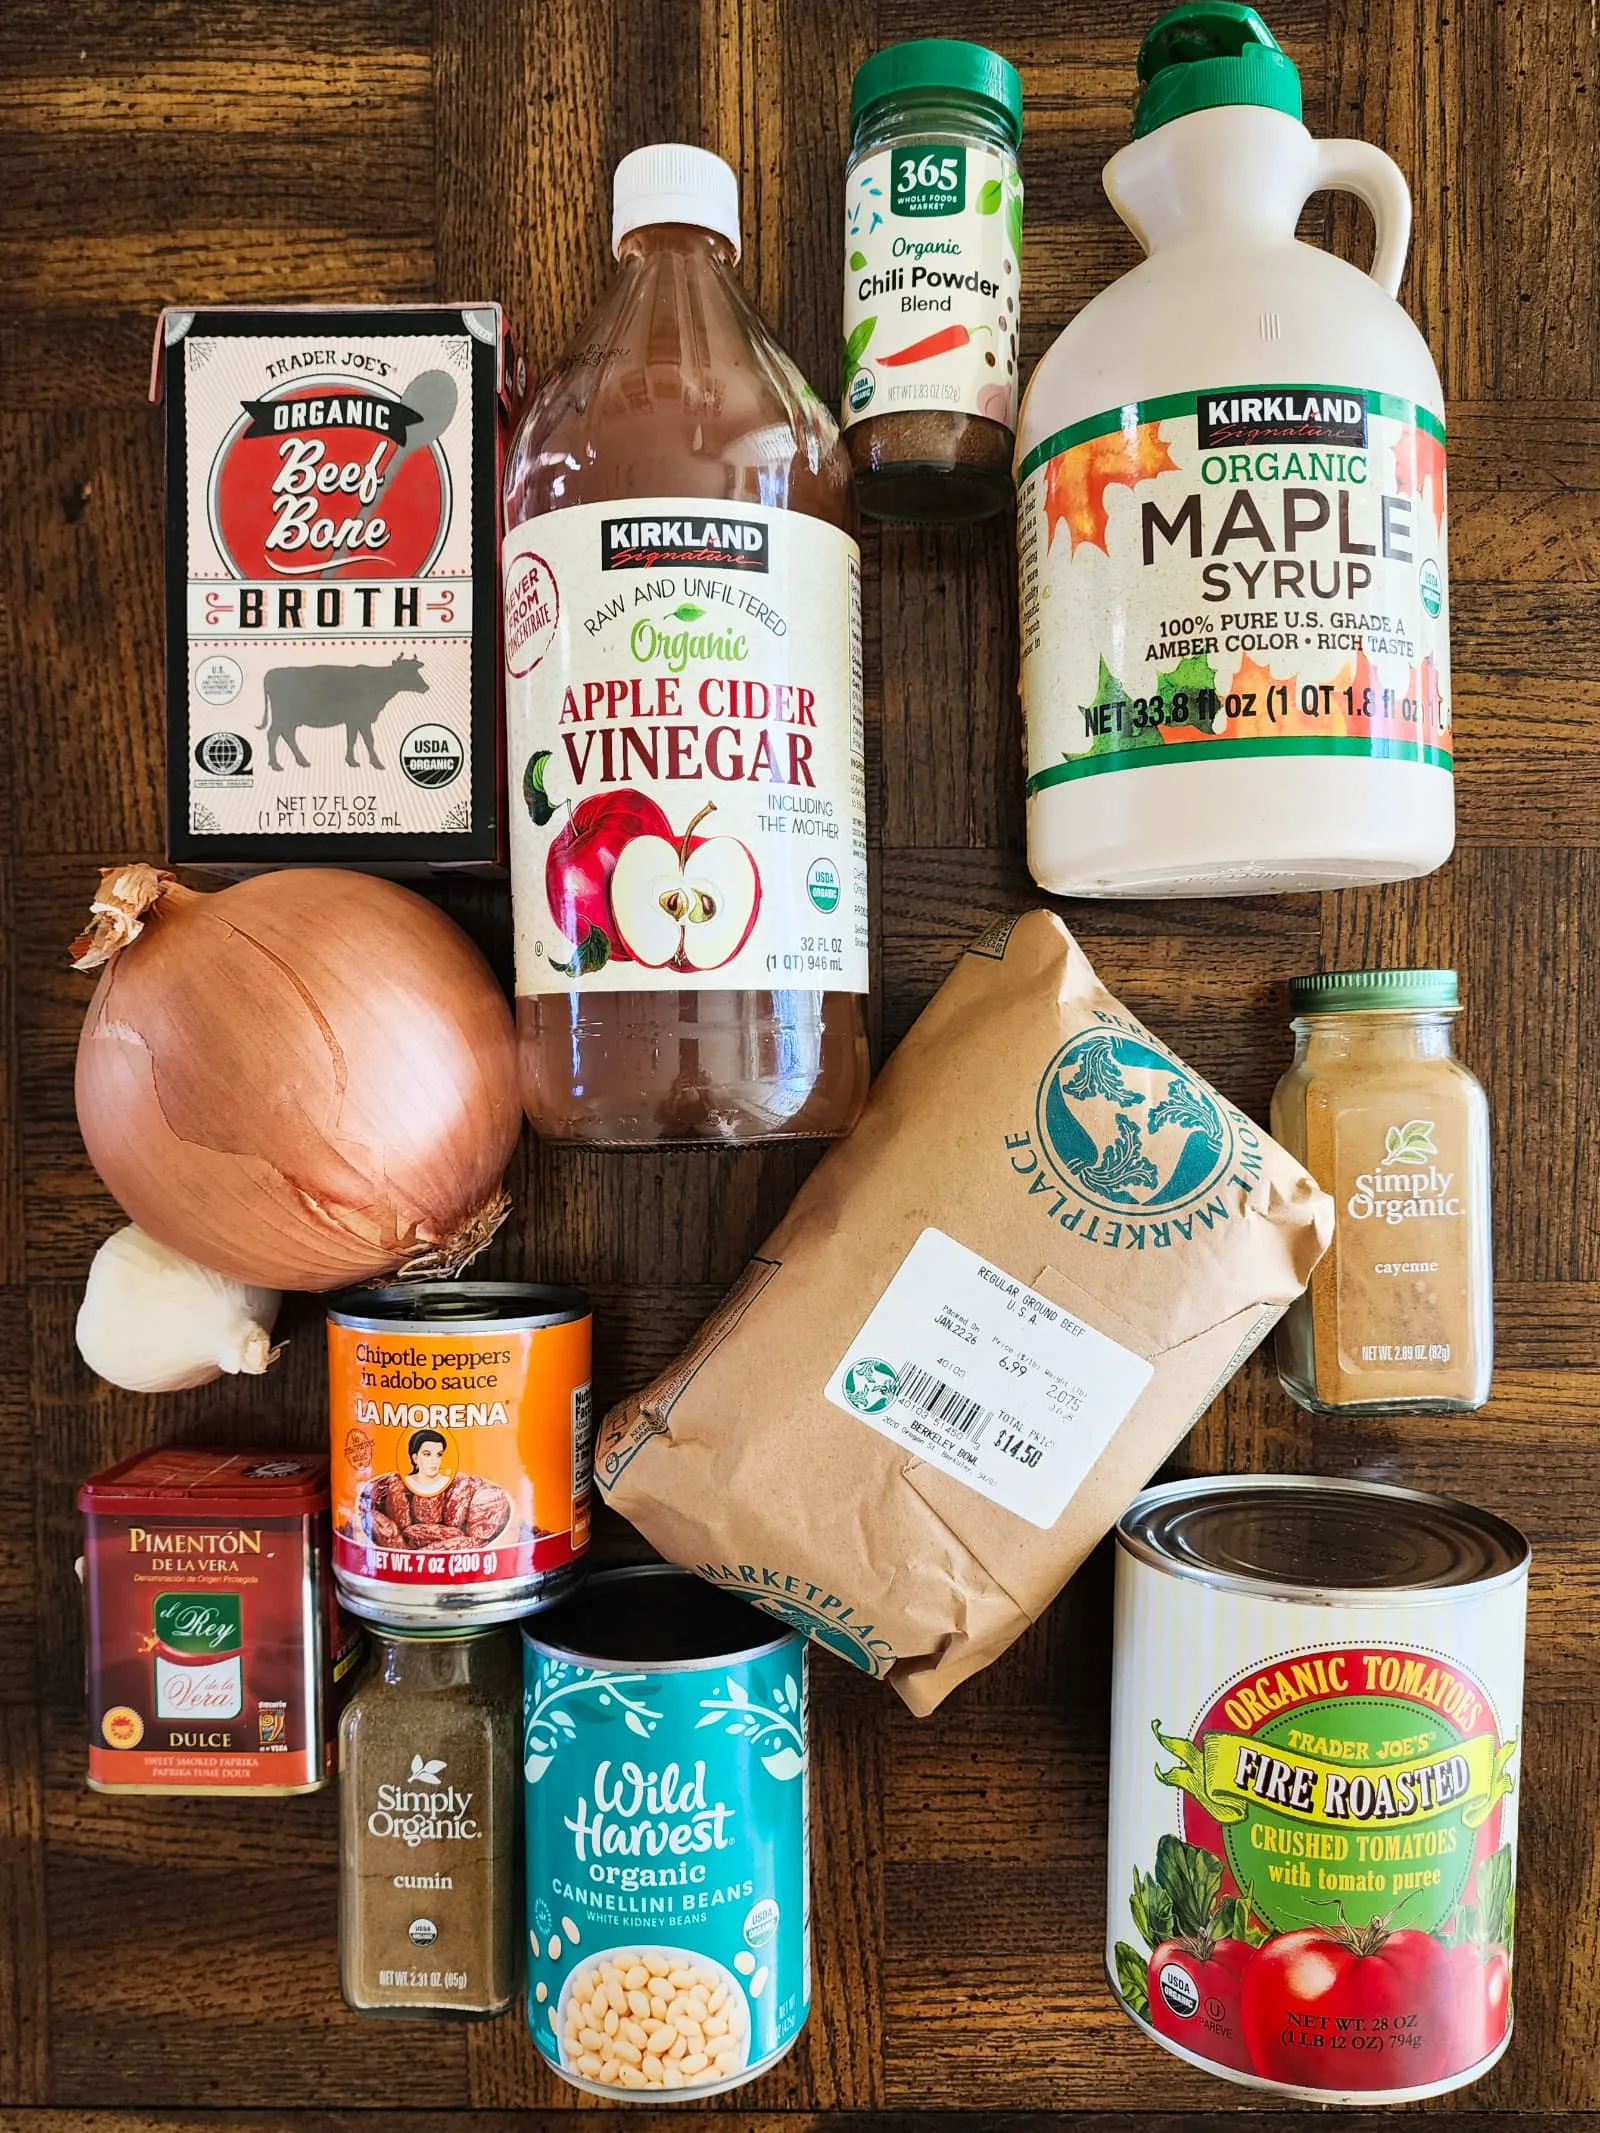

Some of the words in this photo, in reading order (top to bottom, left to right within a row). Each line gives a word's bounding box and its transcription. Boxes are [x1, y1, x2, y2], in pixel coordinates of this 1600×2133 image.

[897, 154, 958, 192] 365
[897, 195, 927, 205] WHOLE
[929, 194, 958, 203] FOODS
[909, 203, 945, 212] MARKET
[892, 237, 962, 261] Organic
[858, 267, 904, 301] Chili
[912, 266, 1000, 300] Powder
[901, 296, 951, 313] Blend
[266, 350, 336, 380] TRADER
[341, 352, 391, 377] JOE'S
[888, 386, 900, 401] NET
[273, 400, 390, 431] ORGANIC
[1208, 397, 1361, 425] KIRKLAND
[1209, 422, 1363, 447] Signature
[272, 438, 385, 504] Beef
[1201, 452, 1367, 486] ORGANIC
[265, 495, 391, 552] Bone
[610, 522, 764, 551] KIRKLAND
[1142, 488, 1413, 566] MAPLE
[610, 546, 764, 569] Signature
[1202, 560, 1372, 602] SYRUP
[238, 587, 422, 629] BROTH
[508, 589, 539, 631] FROM
[583, 594, 626, 636] RAW
[634, 578, 675, 607] AND
[684, 578, 787, 637] UNFILTERED
[507, 603, 552, 658] CONCENTRATE
[1160, 615, 1214, 638] 100%
[1221, 612, 1279, 632] PURE
[1285, 612, 1324, 629] U.S.
[1330, 612, 1392, 633] GRADE
[1395, 617, 1406, 636] A
[630, 617, 749, 673] Organic
[1145, 637, 1219, 662] AMBER
[1225, 635, 1299, 653] COLOR
[1318, 634, 1363, 651] RICH
[1367, 635, 1415, 658] TASTE
[559, 677, 683, 725] APPLE
[698, 677, 818, 728] CIDER
[1085, 700, 1126, 737] NET
[1133, 692, 1189, 728] 33.8
[1199, 688, 1216, 721] fl
[1225, 692, 1257, 718] oz
[1267, 685, 1287, 723] (1
[1301, 684, 1335, 717] QT
[1343, 686, 1375, 719] 1.8
[1383, 686, 1396, 720] fl
[414, 739, 449, 754] USDA
[560, 725, 817, 788] VINEGAR
[409, 758, 454, 771] ORGANIC
[277, 795, 306, 811] NET
[312, 796, 328, 811] 17
[334, 796, 348, 811] FL
[353, 796, 377, 811] OZ
[768, 793, 833, 817] INCLUDING
[258, 811, 270, 830] (1
[278, 812, 294, 827] PT
[301, 812, 306, 827] 1
[313, 811, 342, 830] OZ)
[347, 812, 375, 827] 503
[381, 811, 401, 827] mL
[758, 814, 786, 834] THE
[791, 818, 839, 840] MOTHER
[815, 870, 834, 885] USDA
[800, 936, 814, 951] 32
[817, 937, 830, 952] FL
[831, 937, 843, 953] OZ
[766, 955, 777, 972] (1
[783, 954, 804, 972] QT)
[807, 954, 828, 971] 946
[830, 954, 843, 971] mL
[1004, 1130, 1230, 1251] MARKETPLACE
[1355, 1166, 1454, 1204] Simply
[1374, 1261, 1438, 1277] cayenne
[975, 1265, 1020, 1299] REGULAR
[1020, 1293, 1059, 1323] GROUND
[1059, 1317, 1087, 1340] BEEF
[932, 1313, 979, 1346] JAN.22.26
[356, 1344, 427, 1368] Chipotle
[432, 1350, 510, 1371] peppers
[1362, 1346, 1377, 1361] NET
[1429, 1344, 1450, 1362] (82g)
[361, 1368, 376, 1387] in
[380, 1371, 437, 1391] adobo
[441, 1374, 498, 1390] sauce
[997, 1354, 1028, 1379] 6.99
[897, 1396, 929, 1420] 40103
[1045, 1383, 1083, 1412] 2.075
[383, 1401, 509, 1429] MORENA
[880, 1414, 900, 1430] 2020
[996, 1409, 1026, 1433] TOTAL
[909, 1419, 955, 1452] BERKELEY
[956, 1447, 980, 1467] BOWL
[992, 1427, 1044, 1470] $14.50
[128, 1528, 262, 1554] PIMENTÓN
[152, 1558, 173, 1571] DE
[177, 1558, 195, 1571] LA
[198, 1558, 240, 1572] VERA
[391, 1553, 413, 1573] WT.
[416, 1554, 424, 1573] 7
[428, 1556, 444, 1573] oz
[448, 1553, 480, 1576] (200
[483, 1552, 498, 1575] g)
[160, 1601, 179, 1619] el
[172, 1605, 236, 1648] Rey
[204, 1679, 220, 1692] de
[1224, 1657, 1349, 1731] ORGANIC
[1362, 1655, 1484, 1733] TOMATOES
[169, 1731, 232, 1748] DULCE
[1288, 1729, 1369, 1760] TRADER
[1376, 1732, 1431, 1760] JOE'S
[144, 1757, 175, 1767] SWEET
[176, 1757, 217, 1767] SMOKED
[220, 1757, 259, 1767] PAPRIKA
[152, 1768, 191, 1777] PAPRIKA
[222, 1768, 250, 1778] DOUX
[594, 1760, 707, 1817] Wild
[1235, 1746, 1318, 1813] FIRE
[1323, 1755, 1470, 1820] ROASTED
[377, 1784, 473, 1820] Simply
[564, 1796, 732, 1862] Harvest
[1250, 1824, 1348, 1862] CRUSHED
[1356, 1827, 1457, 1862] TOMATOES
[393, 1872, 453, 1890] cumin
[589, 1861, 706, 1891] organic
[1268, 1862, 1311, 1888] with
[1318, 1869, 1386, 1892] tomato
[1392, 1868, 1441, 1896] puree
[552, 1878, 674, 1913] CANNELLINI
[683, 1880, 753, 1911] BEANS
[586, 1912, 620, 1926] WHITE
[623, 1914, 665, 1927] KIDNEY
[669, 1912, 707, 1926] BEANS
[752, 1908, 773, 1926] USDA
[379, 1970, 395, 1986] NET
[1168, 1973, 1190, 1994] USDA
[1164, 1985, 1193, 2008] ORGANIC
[1199, 2017, 1233, 2038] PAREVE
[1287, 2011, 1330, 2030] NET
[1334, 2017, 1366, 2032] WT.
[1372, 2017, 1388, 2031] 28
[1393, 2014, 1418, 2029] OZ
[1281, 2029, 1294, 2047] (1
[1301, 2032, 1324, 2047] LB
[1331, 2036, 1346, 2049] 12
[1352, 2036, 1384, 2053] OZ)
[1389, 2032, 1422, 2049] 794g
